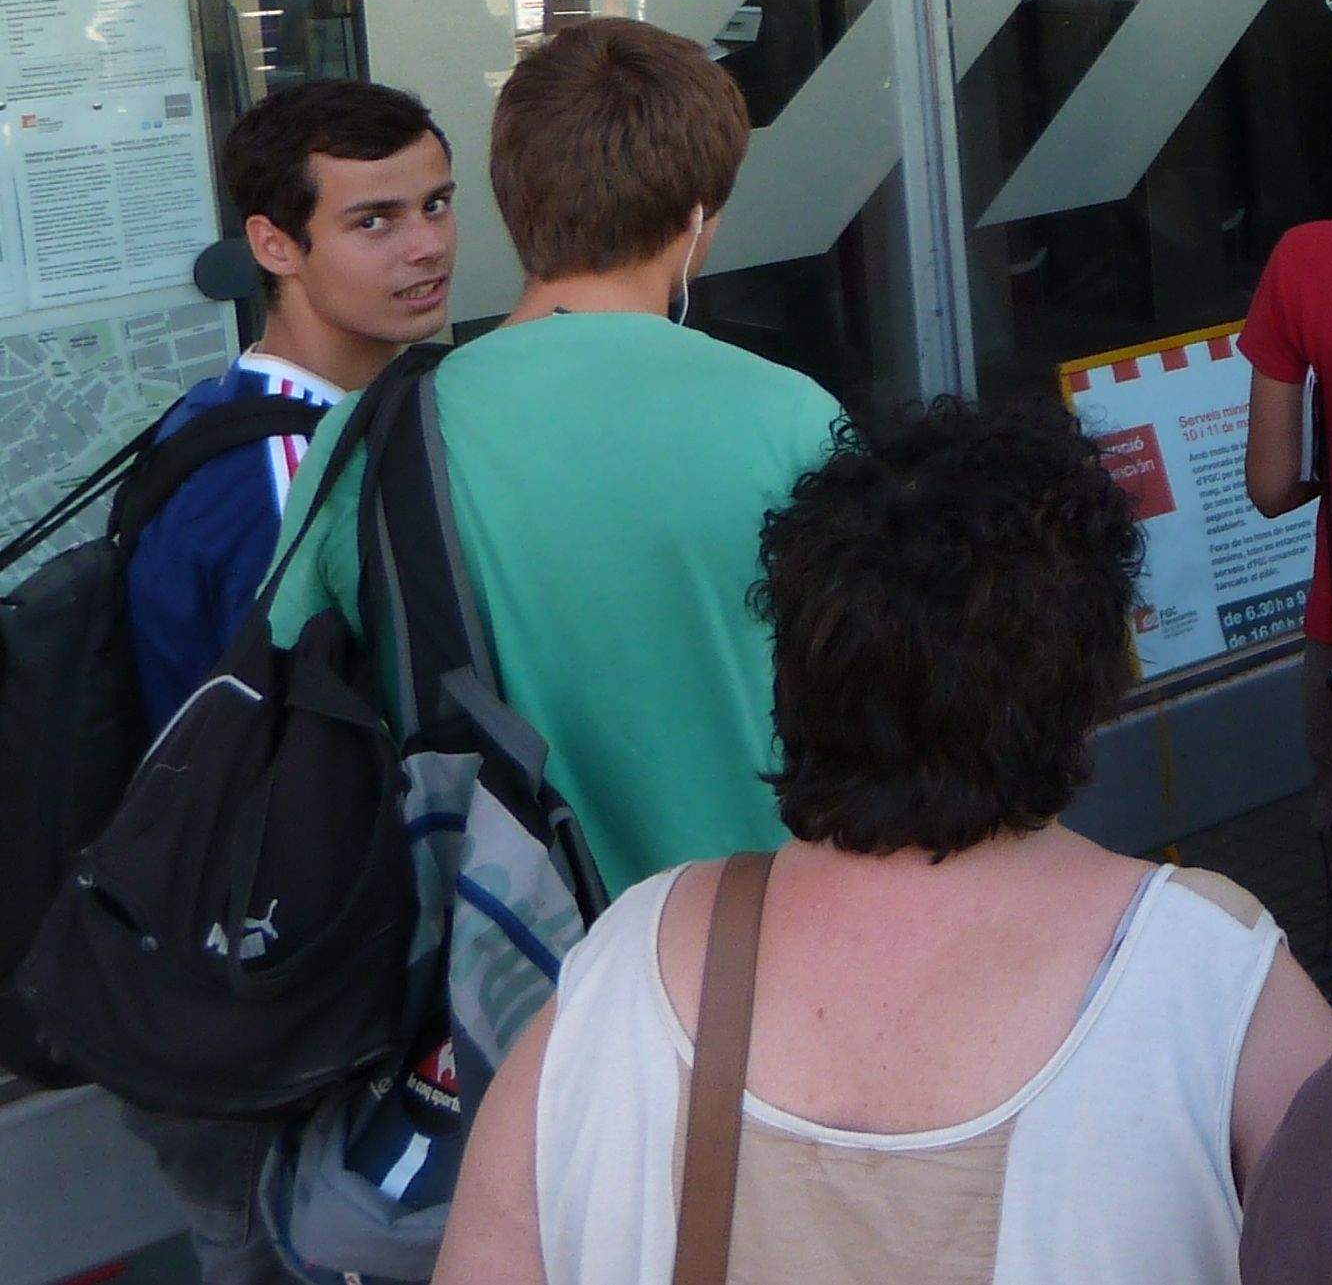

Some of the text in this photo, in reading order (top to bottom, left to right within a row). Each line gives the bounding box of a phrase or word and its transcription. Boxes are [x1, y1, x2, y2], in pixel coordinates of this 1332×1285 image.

[1178, 409, 1221, 428] Serveis
[1183, 428, 1198, 442] 10
[1207, 422, 1219, 436] 11
[1223, 590, 1307, 628] de 6.30 h a 9
[1229, 633, 1248, 649] de
[1250, 621, 1286, 641] 1600
[407, 1072, 418, 1089] le
[416, 1080, 433, 1102] coq
